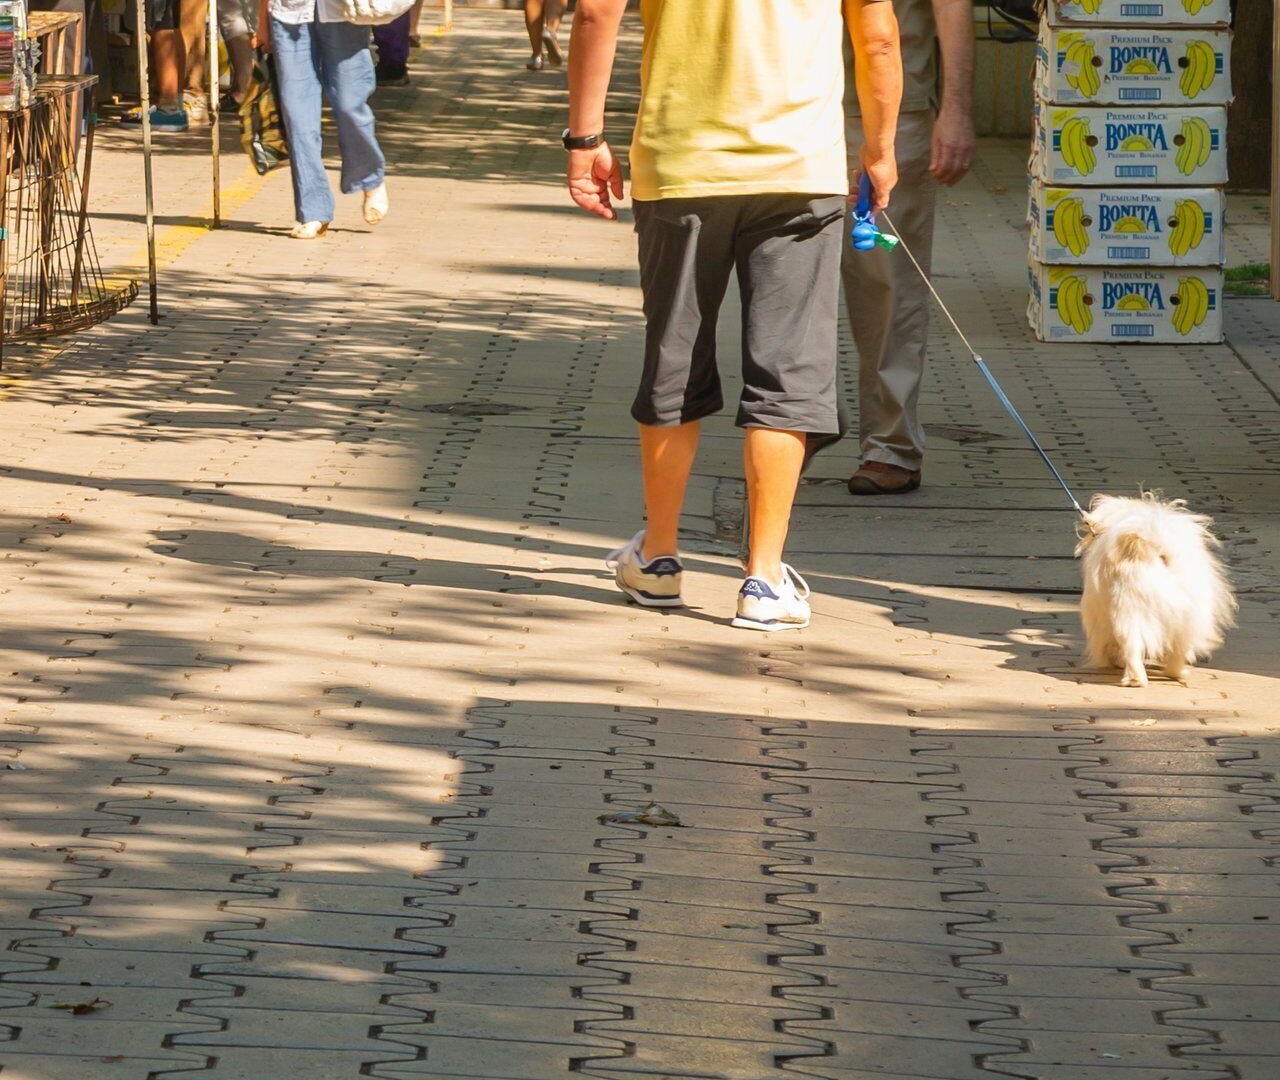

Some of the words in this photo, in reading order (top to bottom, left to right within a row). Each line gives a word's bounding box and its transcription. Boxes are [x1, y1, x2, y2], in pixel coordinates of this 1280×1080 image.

[1111, 35, 1150, 43] PREMIUM
[1152, 35, 1173, 44] PACK
[1109, 47, 1175, 73] BONITA
[1105, 112, 1146, 120] PREMIUM
[1147, 112, 1168, 120] PACK
[1105, 124, 1171, 151] BONITA
[1100, 194, 1140, 202] PREMIUM
[1141, 194, 1162, 202] PACK
[1098, 205, 1162, 233] BONITA
[1102, 271, 1142, 279] PREMIUM
[1144, 271, 1165, 279] PACK
[1101, 283, 1166, 310] BONITA
